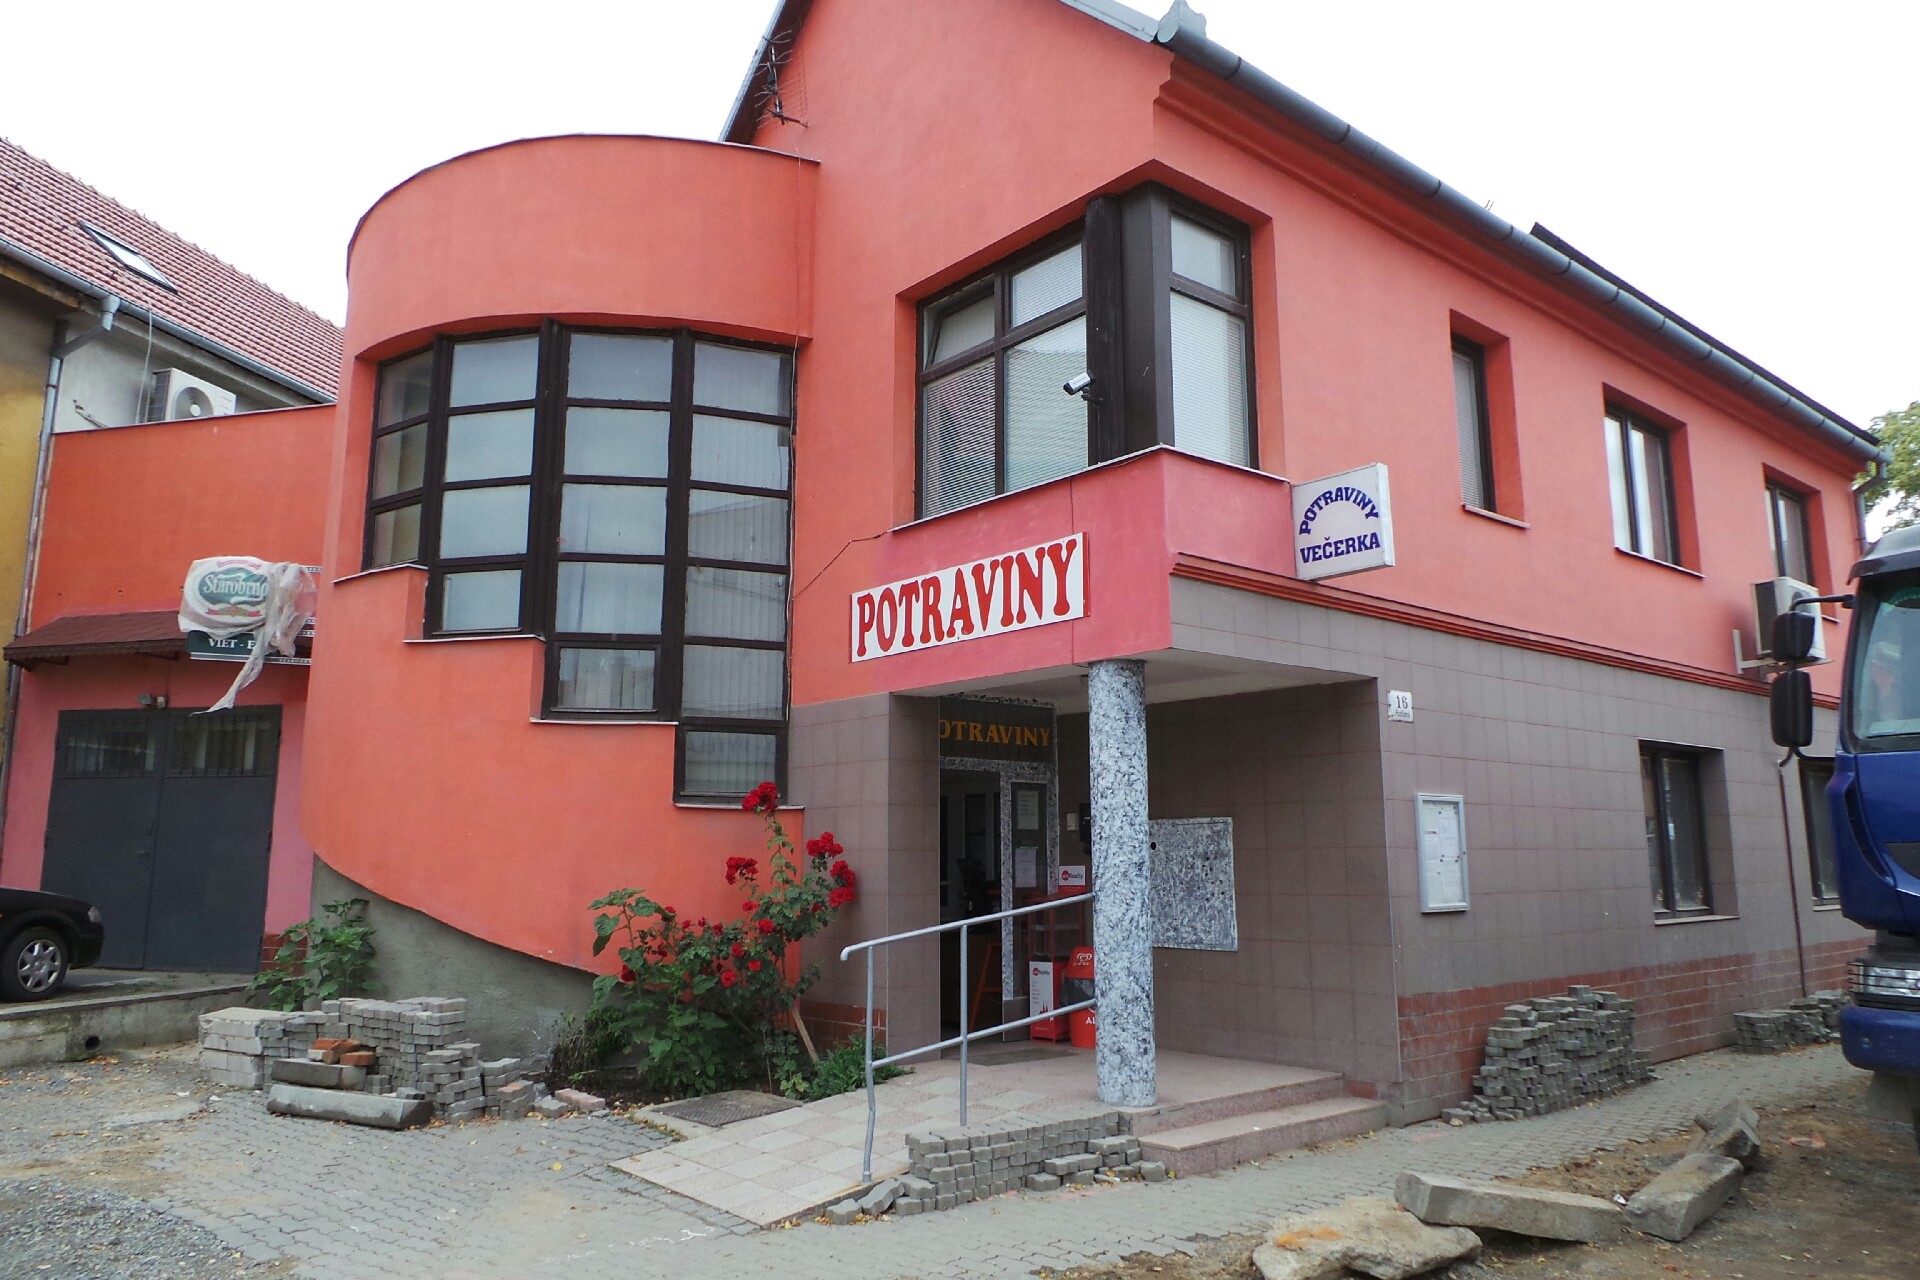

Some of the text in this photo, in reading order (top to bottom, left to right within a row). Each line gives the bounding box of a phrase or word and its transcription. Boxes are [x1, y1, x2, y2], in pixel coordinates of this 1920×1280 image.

[1299, 487, 1379, 536] POTRAVINY
[1300, 532, 1381, 564] VEČERKA
[857, 538, 1078, 658] POTRAVINY
[208, 639, 237, 649] VIET
[1396, 695, 1408, 709] 16
[939, 719, 1050, 746] OTRAVINY
